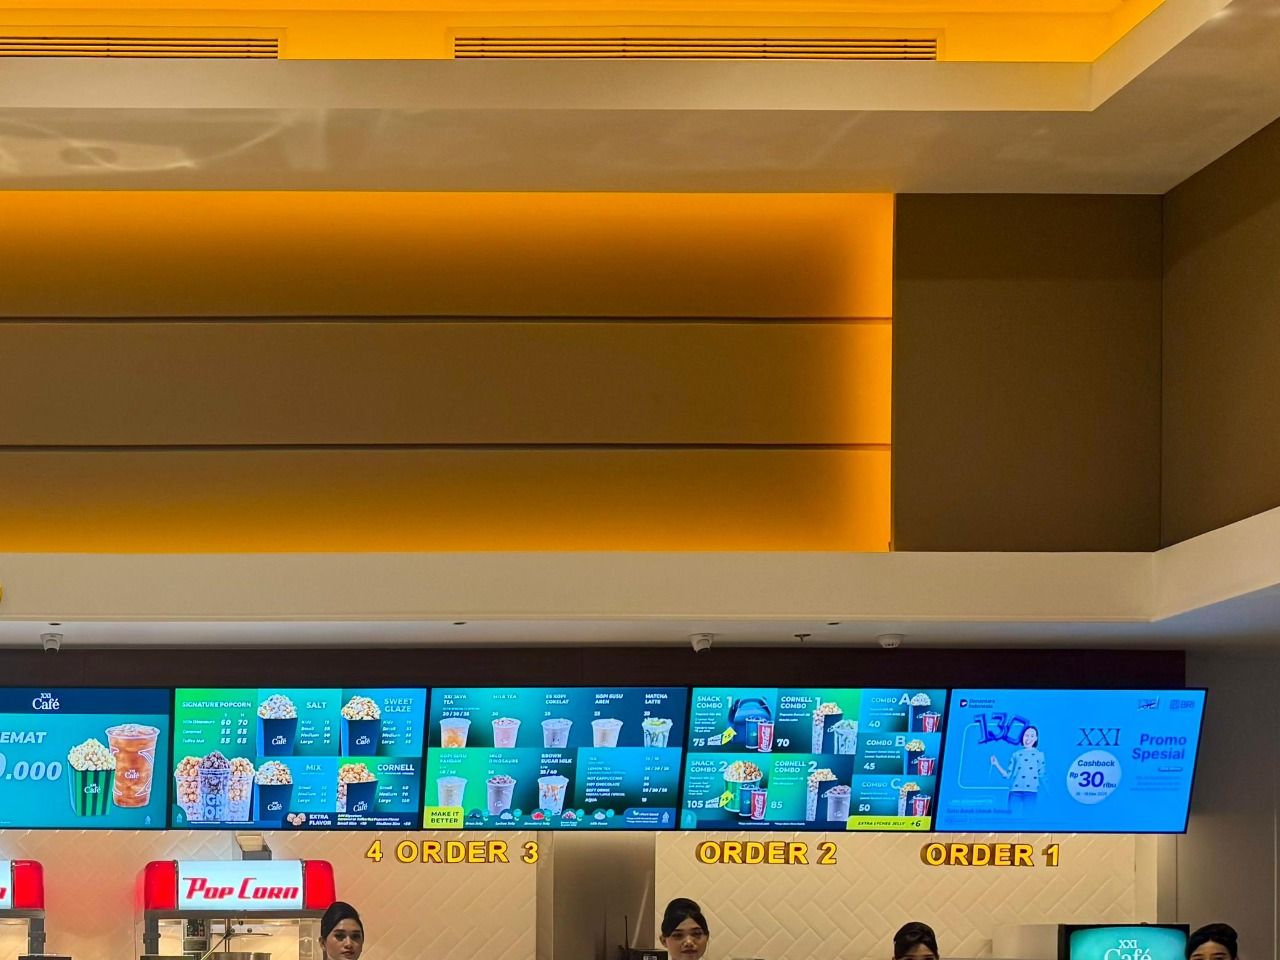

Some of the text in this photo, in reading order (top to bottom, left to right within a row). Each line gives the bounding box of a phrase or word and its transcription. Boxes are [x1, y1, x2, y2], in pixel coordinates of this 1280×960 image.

[32, 698, 60, 710] Café
[898, 693, 910, 705] A
[693, 738, 705, 746] 75
[777, 739, 790, 747] 70
[895, 736, 906, 747] B
[1077, 728, 1121, 747] XXI
[1139, 733, 1187, 746] Promo
[1131, 748, 1185, 762] Spesial
[719, 761, 728, 772] 2
[807, 761, 818, 772] 2
[1077, 759, 1115, 767] Cashback
[891, 778, 901, 789] C
[1070, 772, 1079, 780] Rp
[1078, 771, 1104, 787] 30
[366, 841, 539, 864] 4 ORDER 3
[698, 841, 837, 864] ORDER 2
[924, 843, 1034, 866] ORDER
[1119, 940, 1137, 949] XXI
